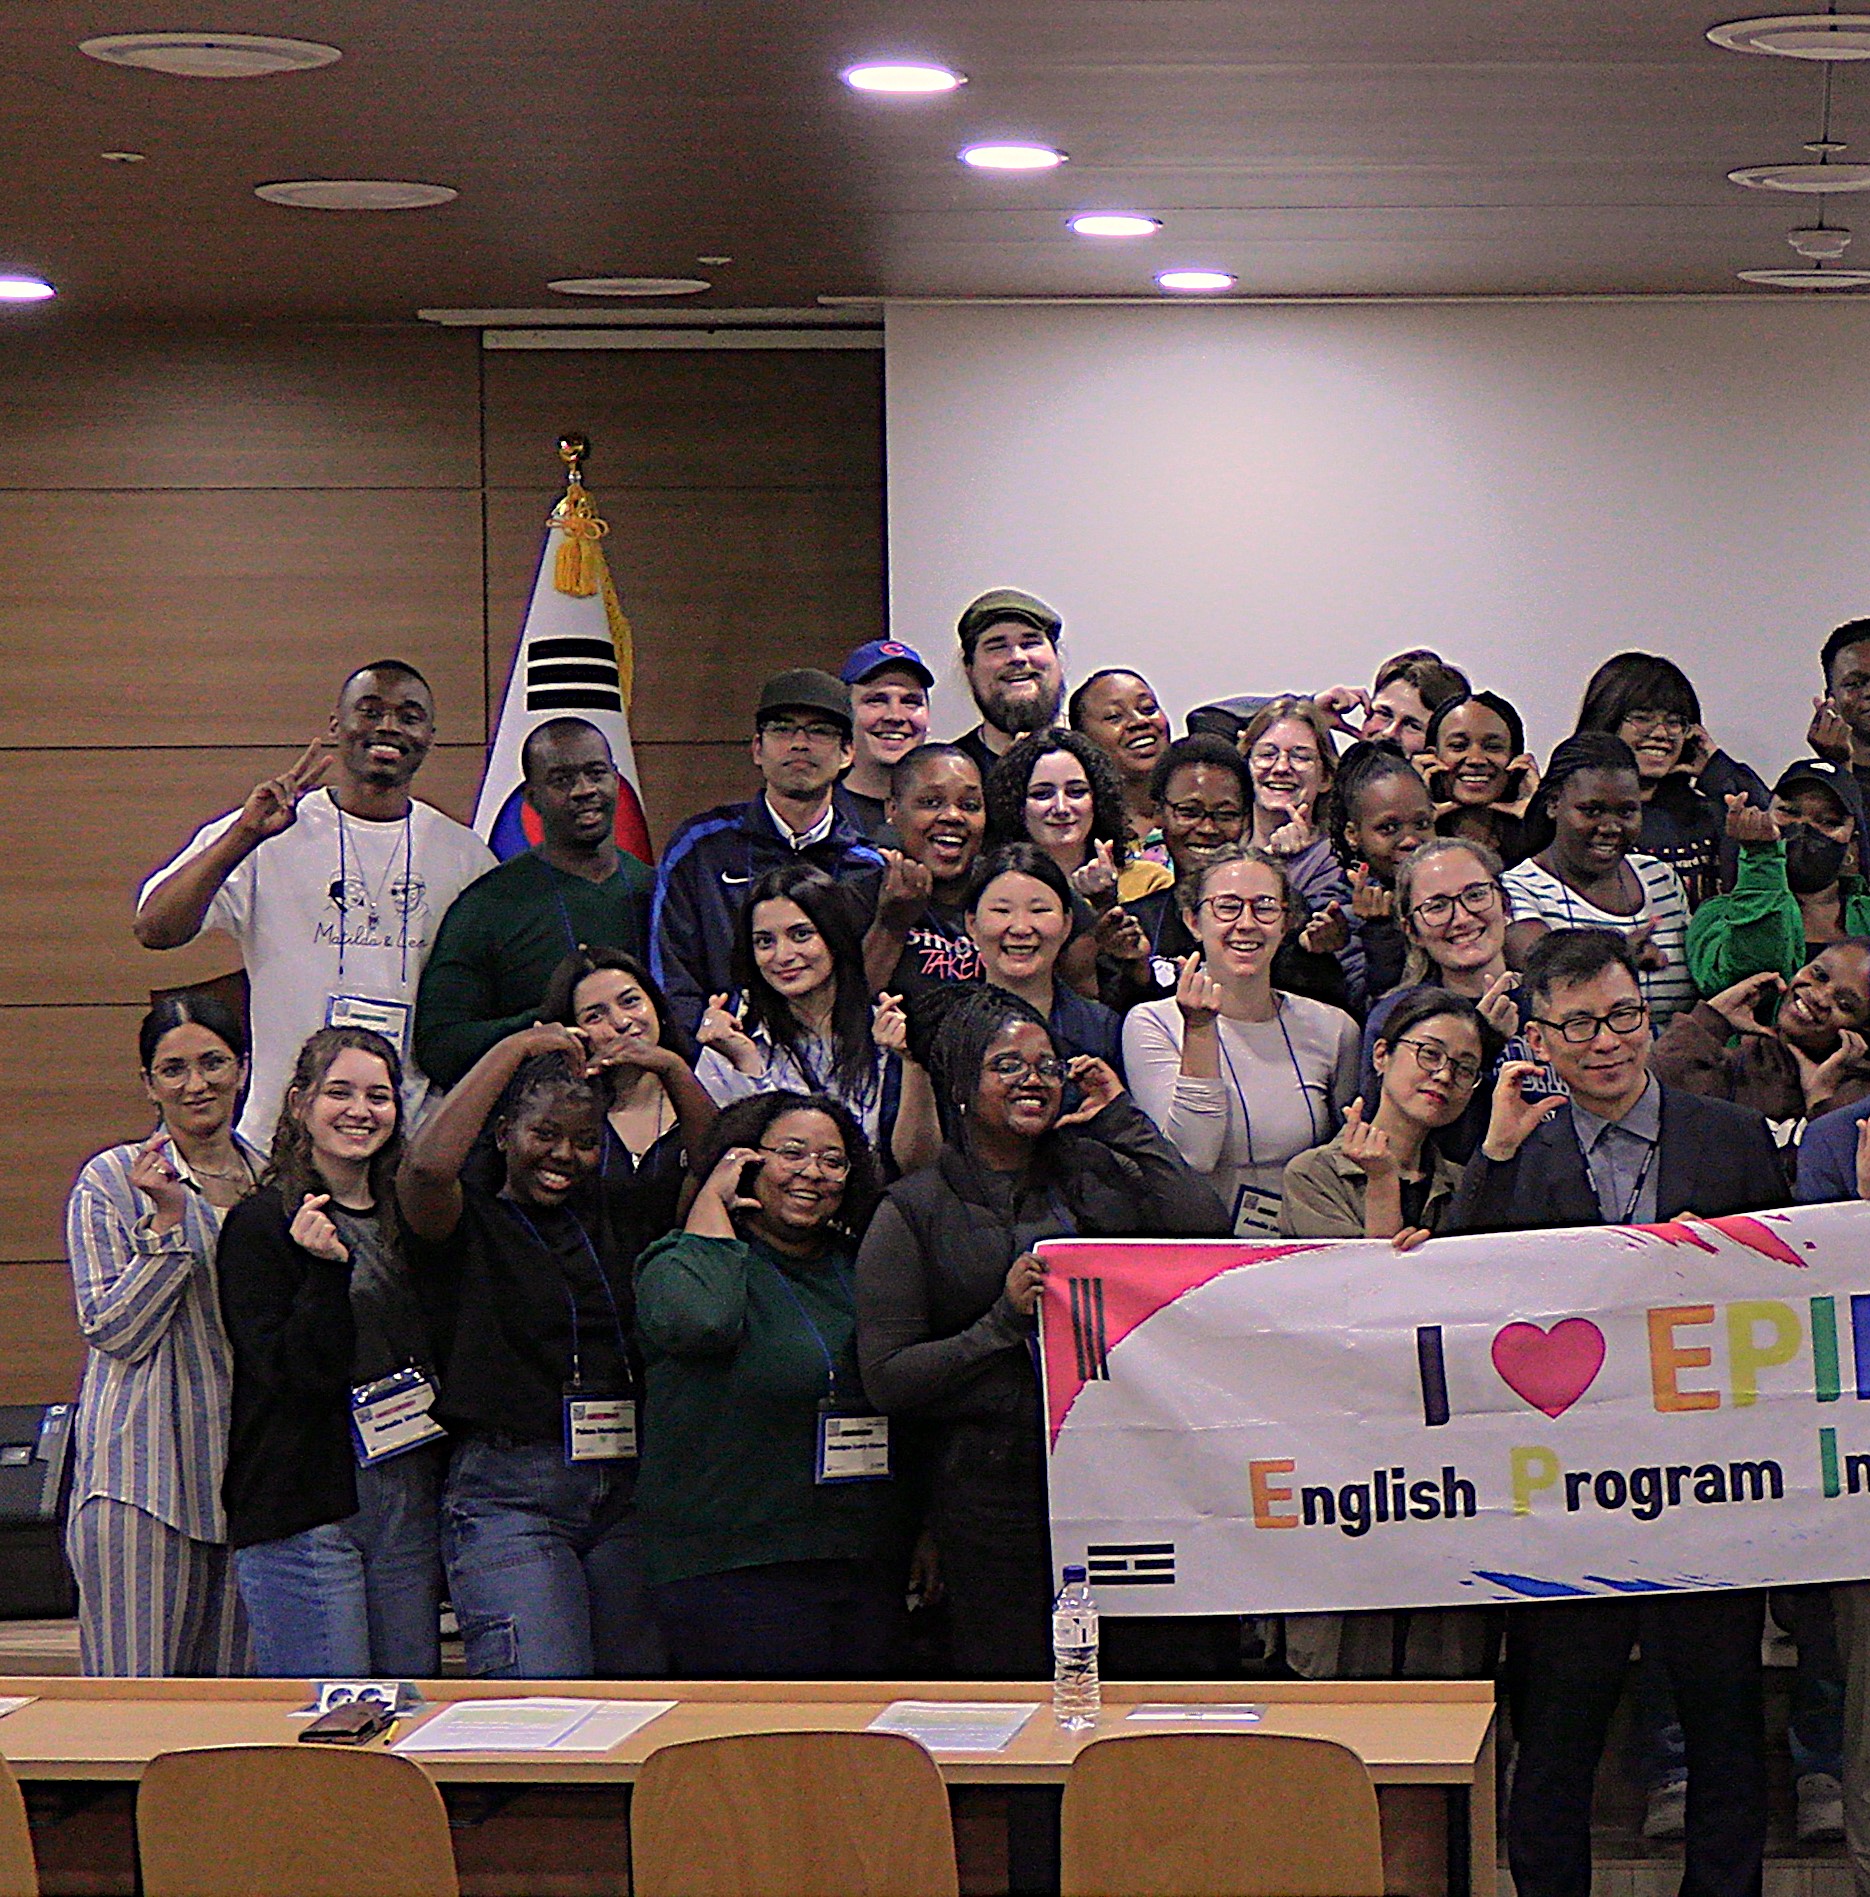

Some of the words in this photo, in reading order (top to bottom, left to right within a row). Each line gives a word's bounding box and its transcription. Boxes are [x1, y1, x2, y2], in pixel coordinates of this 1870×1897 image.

[1417, 1326, 1450, 1427] I
[1249, 1458, 1477, 1537] English
[1510, 1446, 1784, 1522] Program
